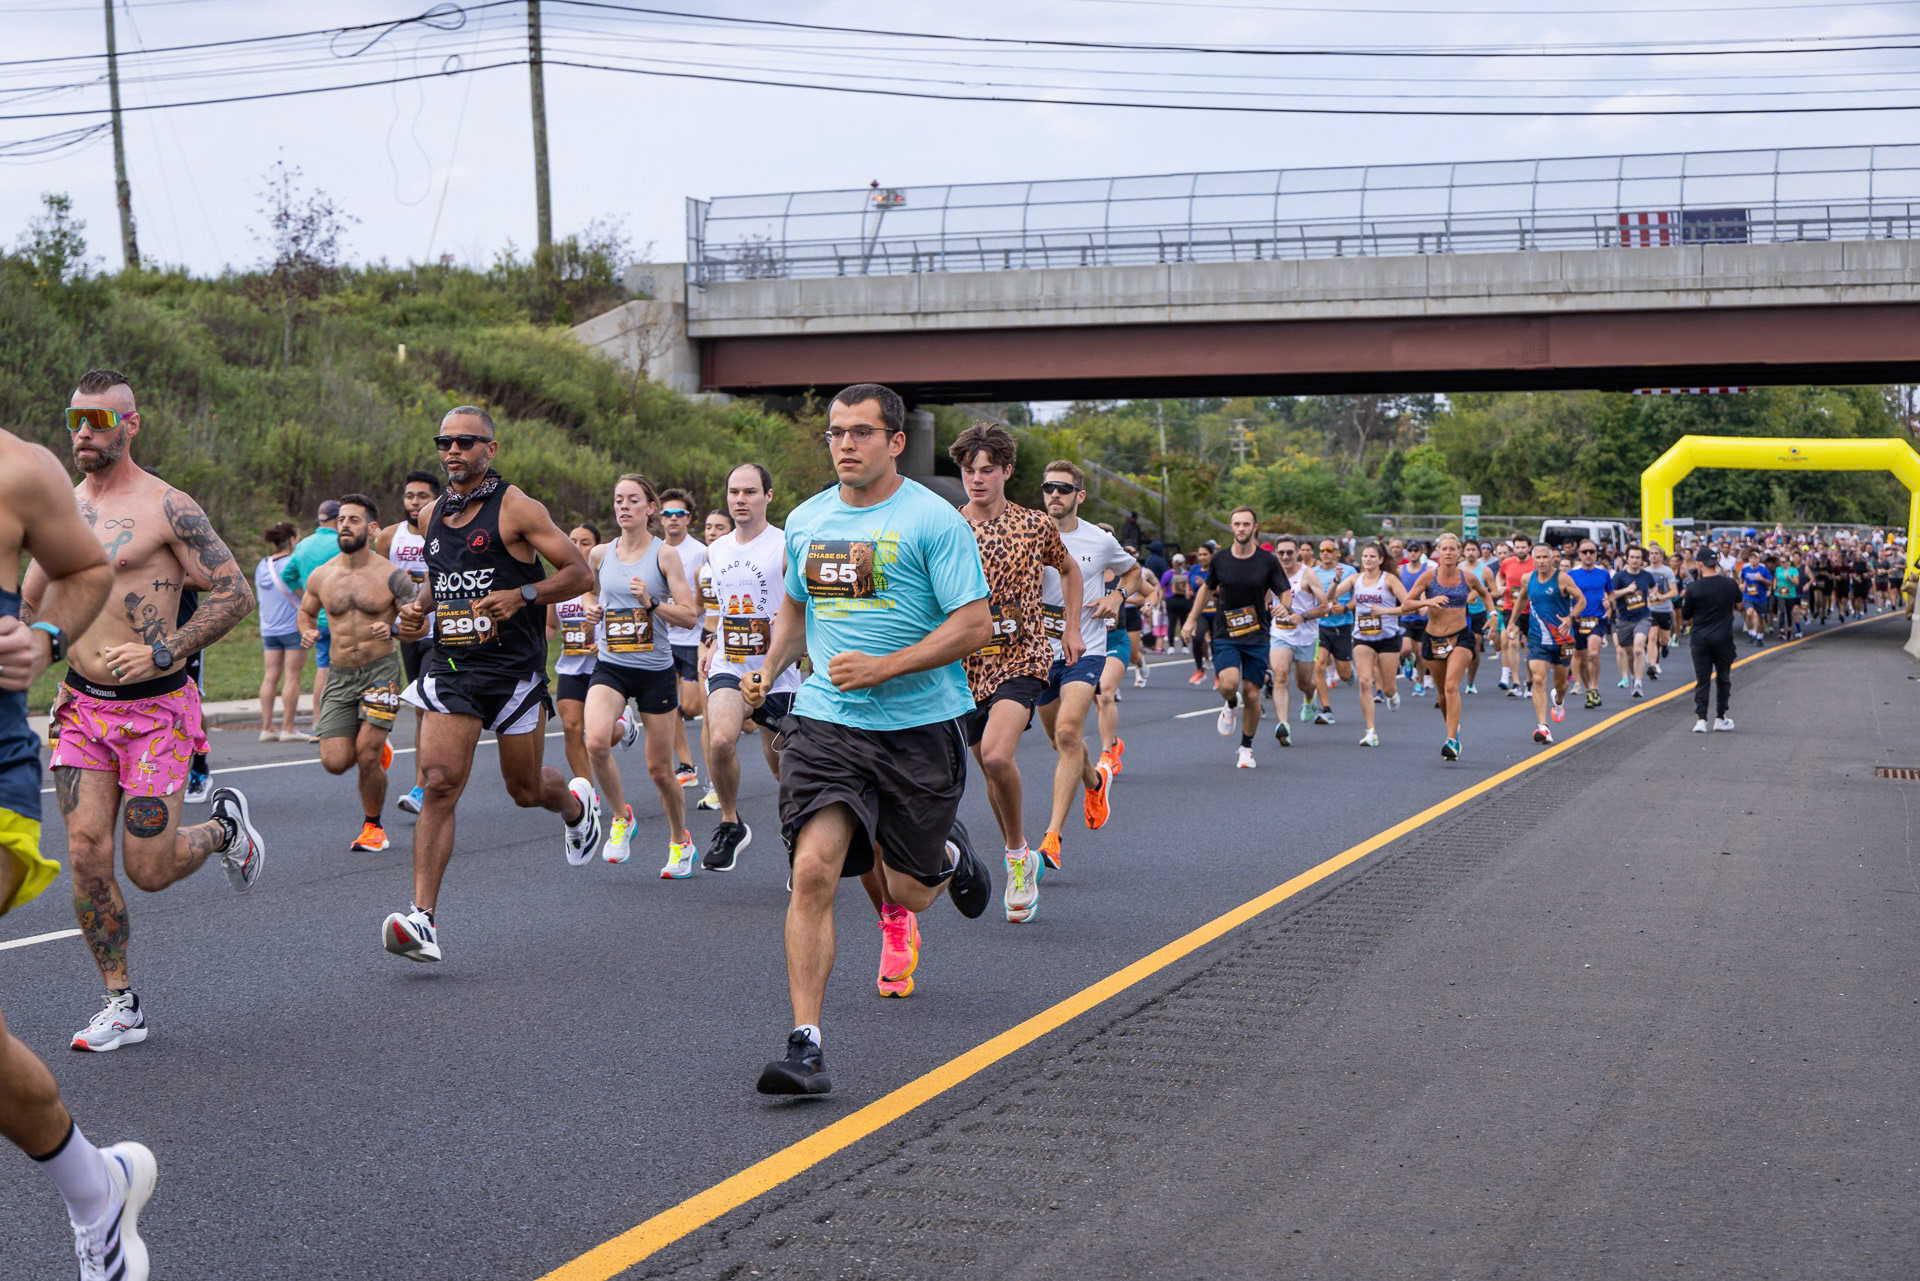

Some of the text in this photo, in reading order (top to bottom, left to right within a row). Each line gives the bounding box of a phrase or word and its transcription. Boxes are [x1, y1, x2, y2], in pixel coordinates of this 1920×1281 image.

[877, 541, 898, 552] 10K
[881, 552, 898, 564] 5K
[434, 568, 495, 592] ROSE
[819, 563, 857, 583] 55
[745, 561, 768, 612] RUNNERS
[835, 599, 896, 611] MARATHON
[441, 616, 492, 635] 290
[1043, 616, 1067, 632] 53
[1230, 614, 1254, 627] 132
[608, 622, 648, 636] 237
[565, 631, 586, 643] 88
[728, 631, 764, 646] 212
